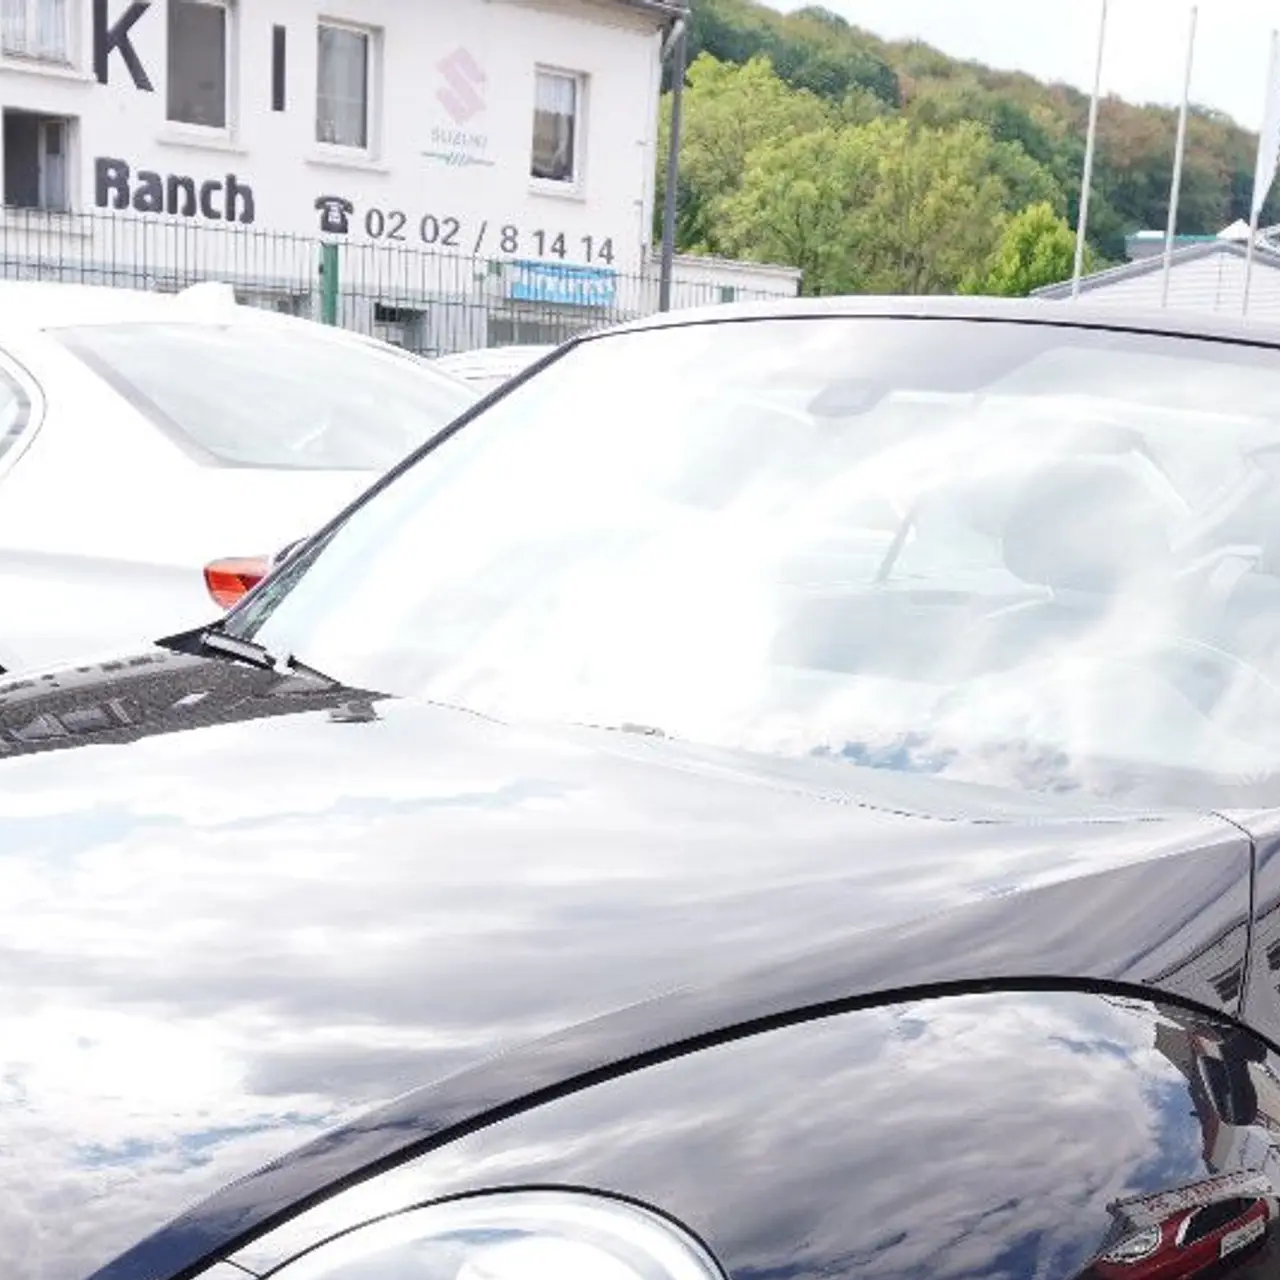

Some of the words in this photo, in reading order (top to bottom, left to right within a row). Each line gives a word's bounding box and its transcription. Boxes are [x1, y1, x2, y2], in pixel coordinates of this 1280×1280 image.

[94, 157, 255, 224] Ranch
[365, 207, 407, 241] 02
[420, 213, 462, 247] 02
[473, 220, 489, 255] /
[500, 225, 519, 253] 8
[532, 229, 567, 260] 14
[580, 235, 615, 265] 14
